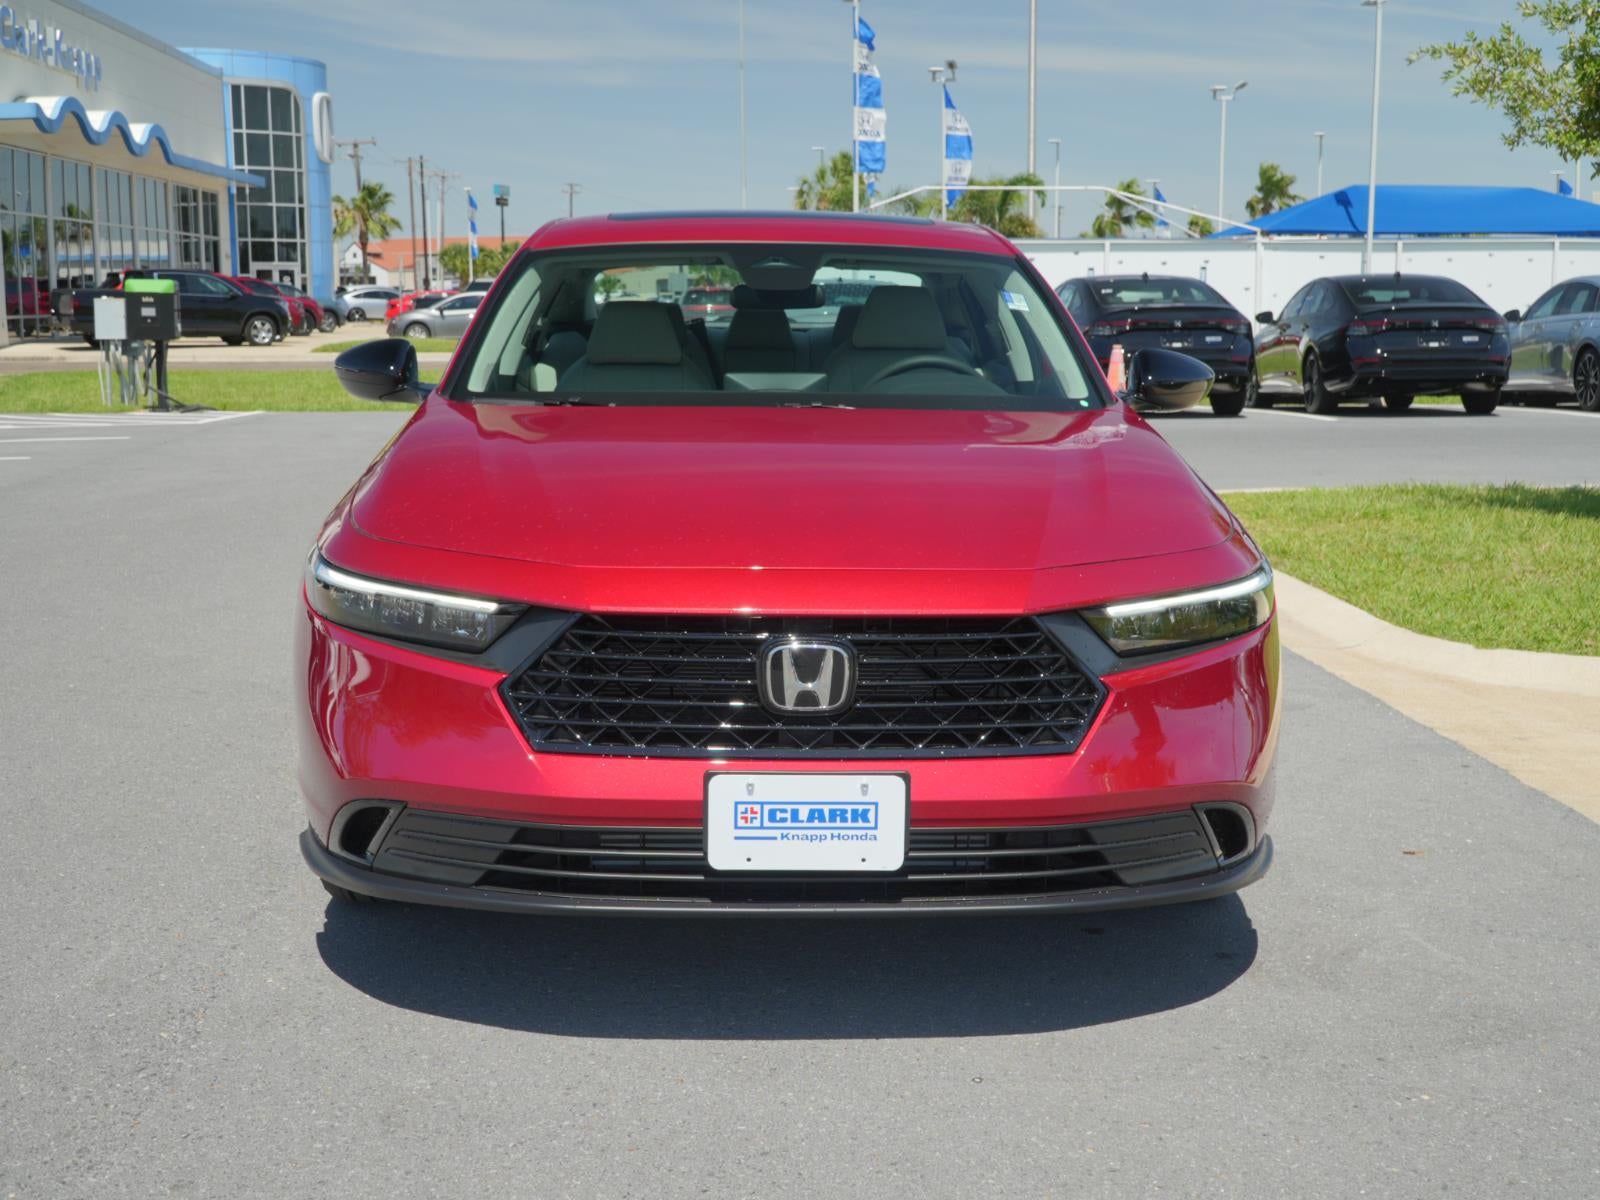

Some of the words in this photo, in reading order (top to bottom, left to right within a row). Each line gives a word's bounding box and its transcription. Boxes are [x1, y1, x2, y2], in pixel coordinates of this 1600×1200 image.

[768, 808, 871, 823] CLARK
[780, 832, 827, 842] Knapp
[830, 832, 878, 841] Honda
